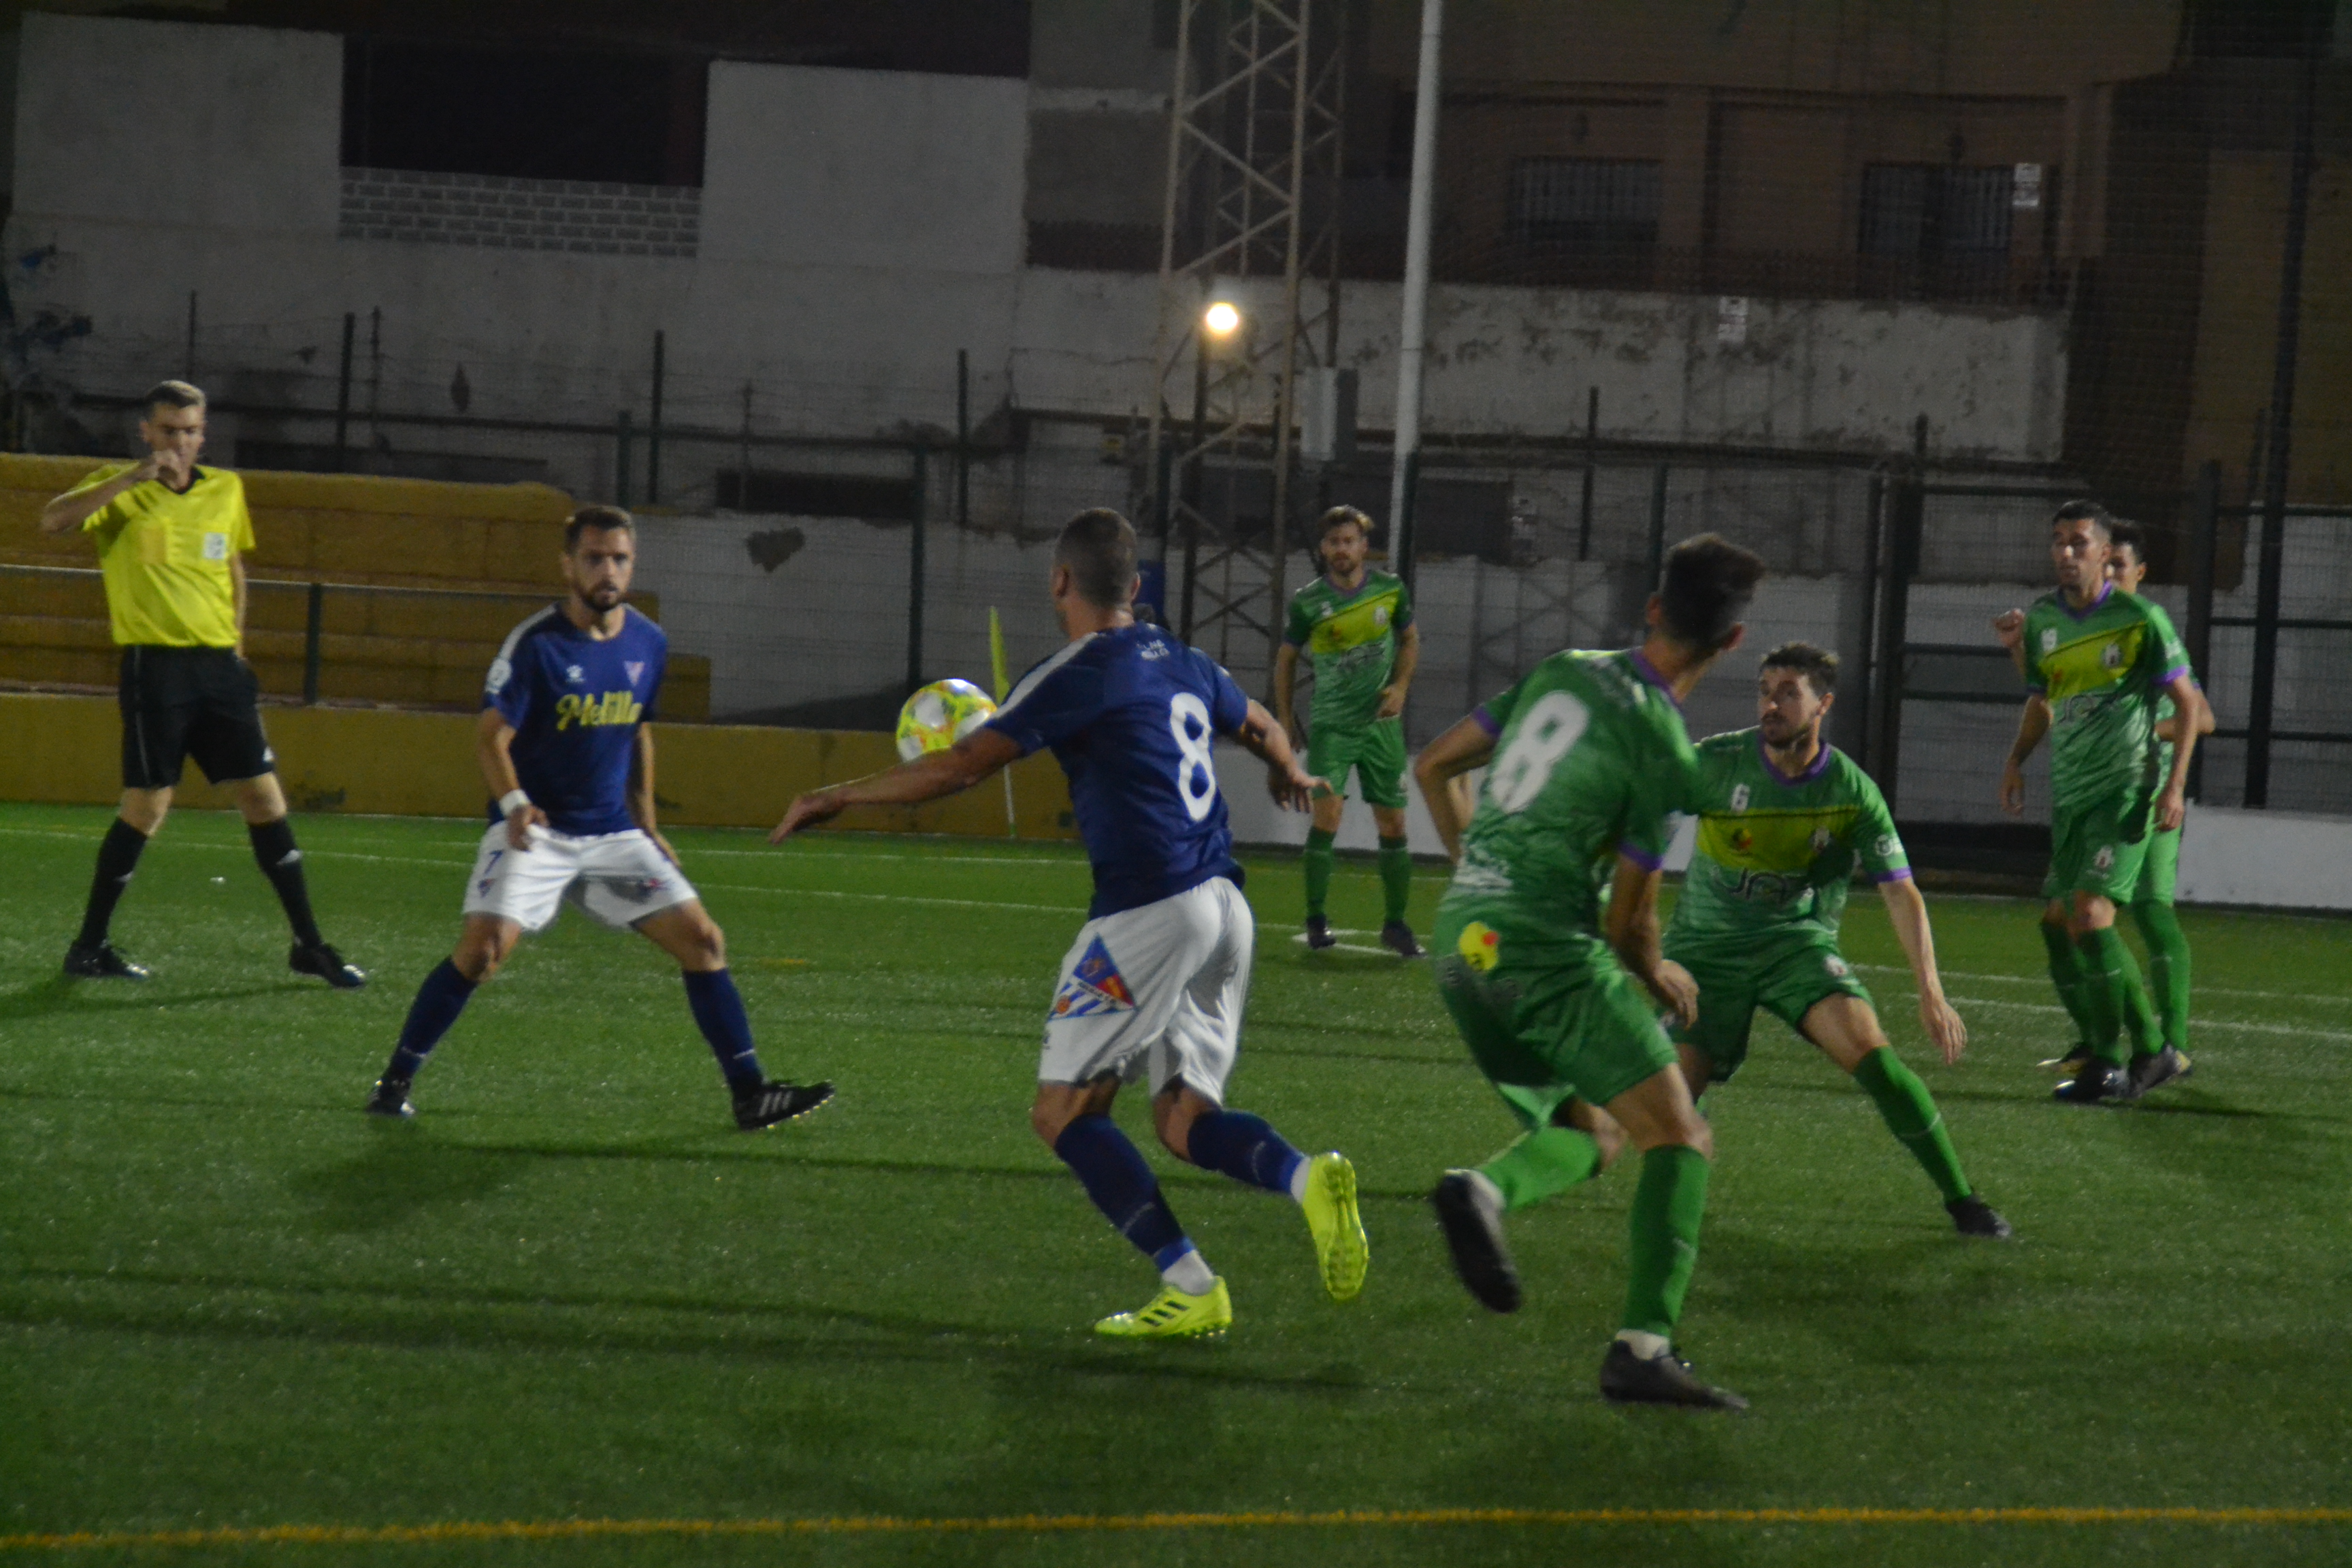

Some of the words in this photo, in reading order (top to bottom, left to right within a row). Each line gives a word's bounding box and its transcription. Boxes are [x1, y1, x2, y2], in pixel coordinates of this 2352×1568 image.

[1170, 692, 1215, 821] 8
[1492, 690, 1590, 814] 8
[1731, 784, 1750, 815] 6
